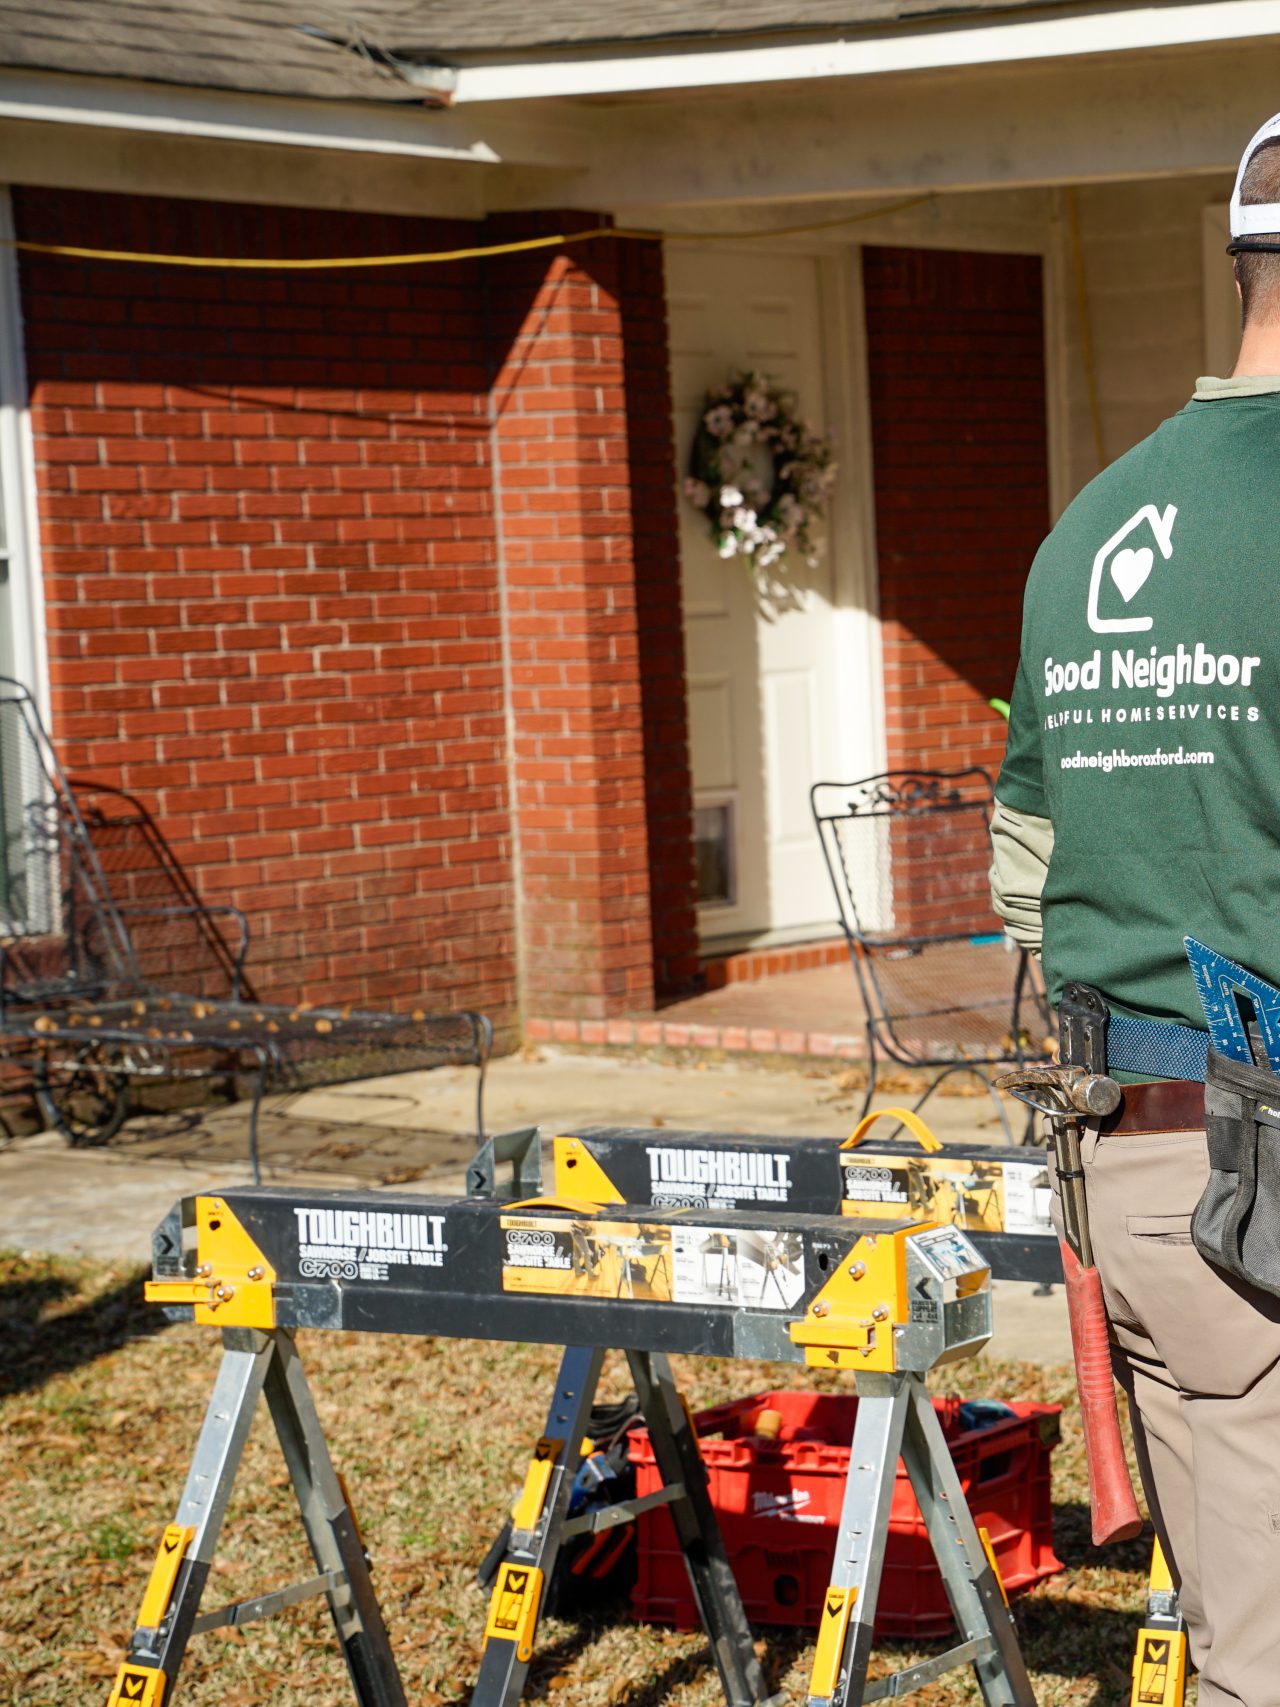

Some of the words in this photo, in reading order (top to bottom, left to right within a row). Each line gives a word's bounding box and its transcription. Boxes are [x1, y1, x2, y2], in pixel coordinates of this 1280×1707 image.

[1112, 643, 1261, 698] Neighbor
[1044, 709, 1093, 731] ELPFUL
[1061, 746, 1215, 772] oodneighboroxford.com
[645, 1147, 791, 1189] TOUGHBUILT
[756, 1188, 788, 1202] TABLE
[293, 1207, 447, 1252] TOUGHBUILT
[506, 1230, 556, 1246] C700
[299, 1244, 357, 1261] SAWHORSE
[366, 1249, 409, 1264] JOBSITE
[410, 1251, 444, 1267] TABLE
[299, 1258, 359, 1280] C700
